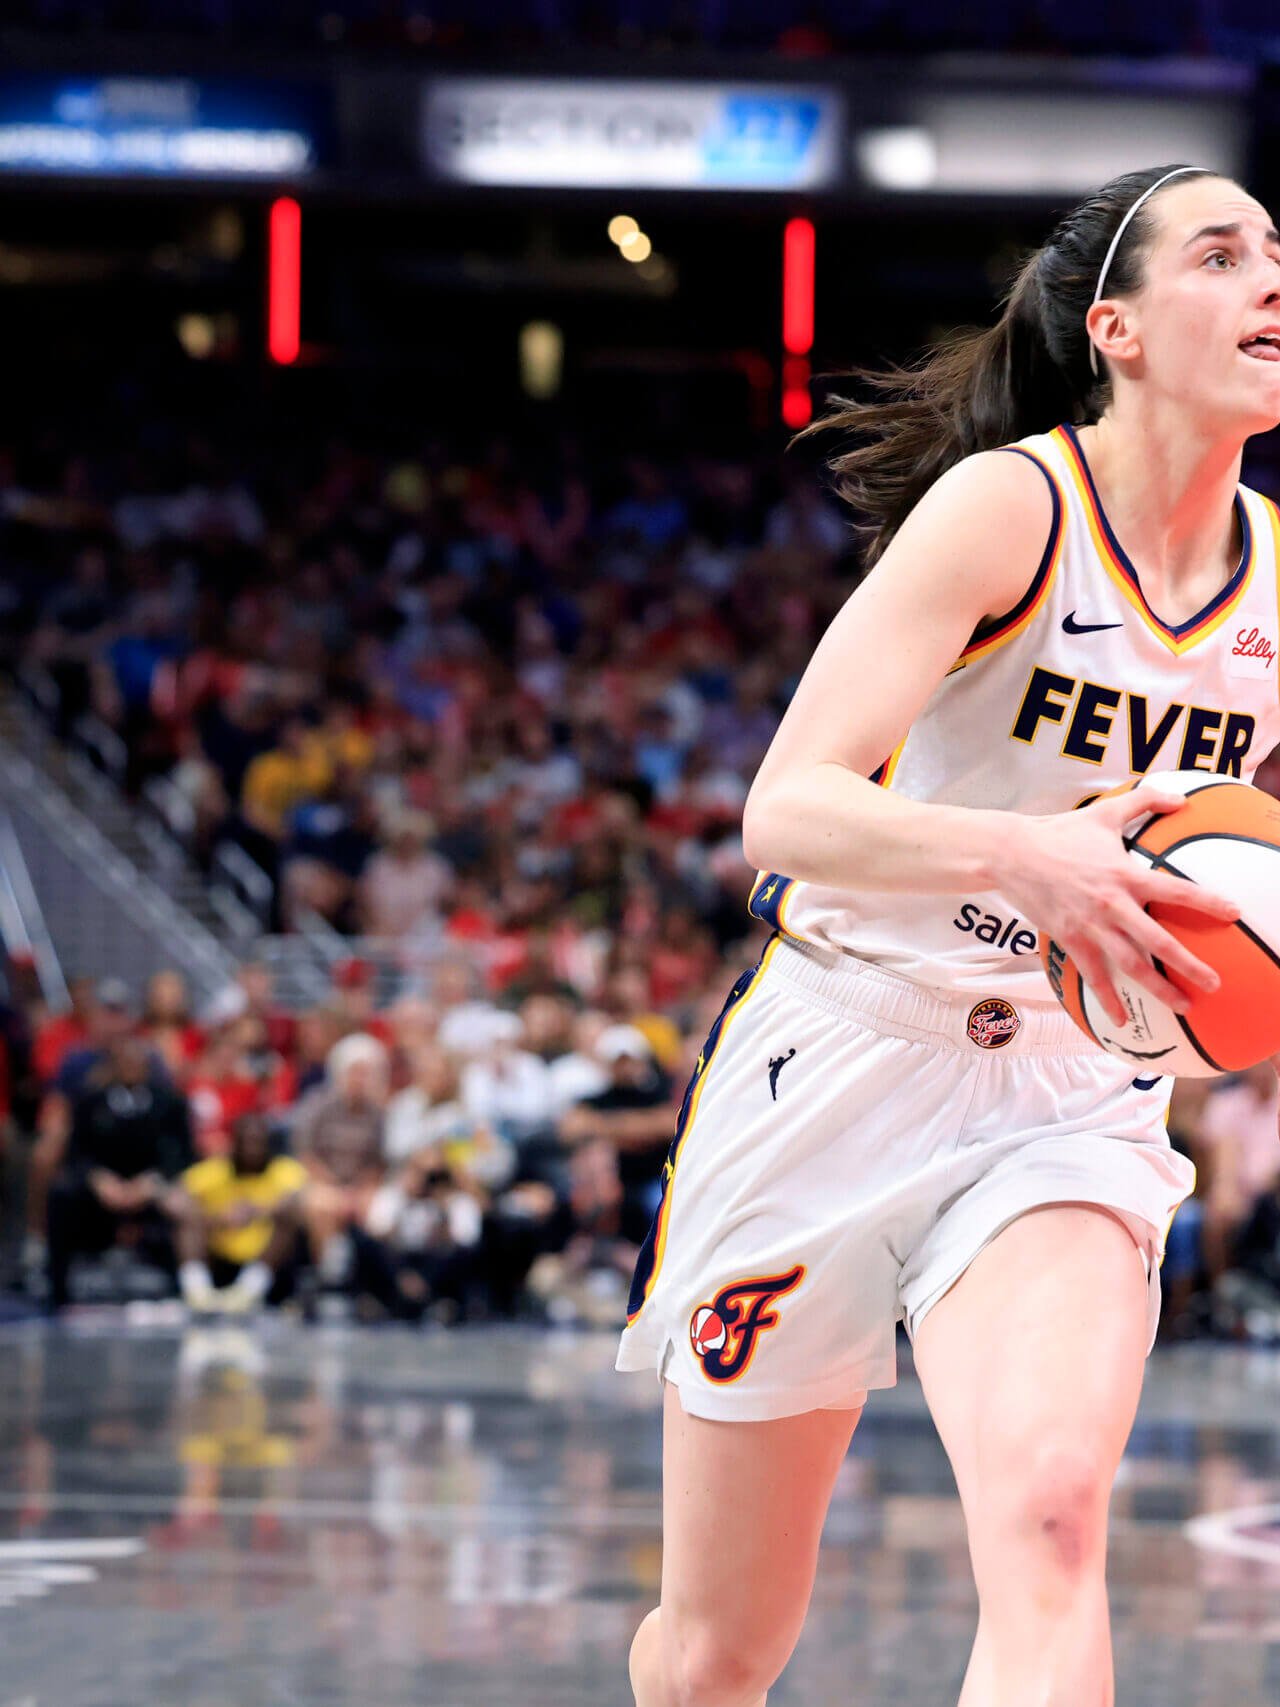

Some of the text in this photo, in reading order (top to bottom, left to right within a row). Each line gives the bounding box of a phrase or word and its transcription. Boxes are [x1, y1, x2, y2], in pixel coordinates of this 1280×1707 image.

[1232, 627, 1276, 668] Lilly
[1009, 664, 1255, 778] FEVER
[967, 1012, 1020, 1037] Fever
